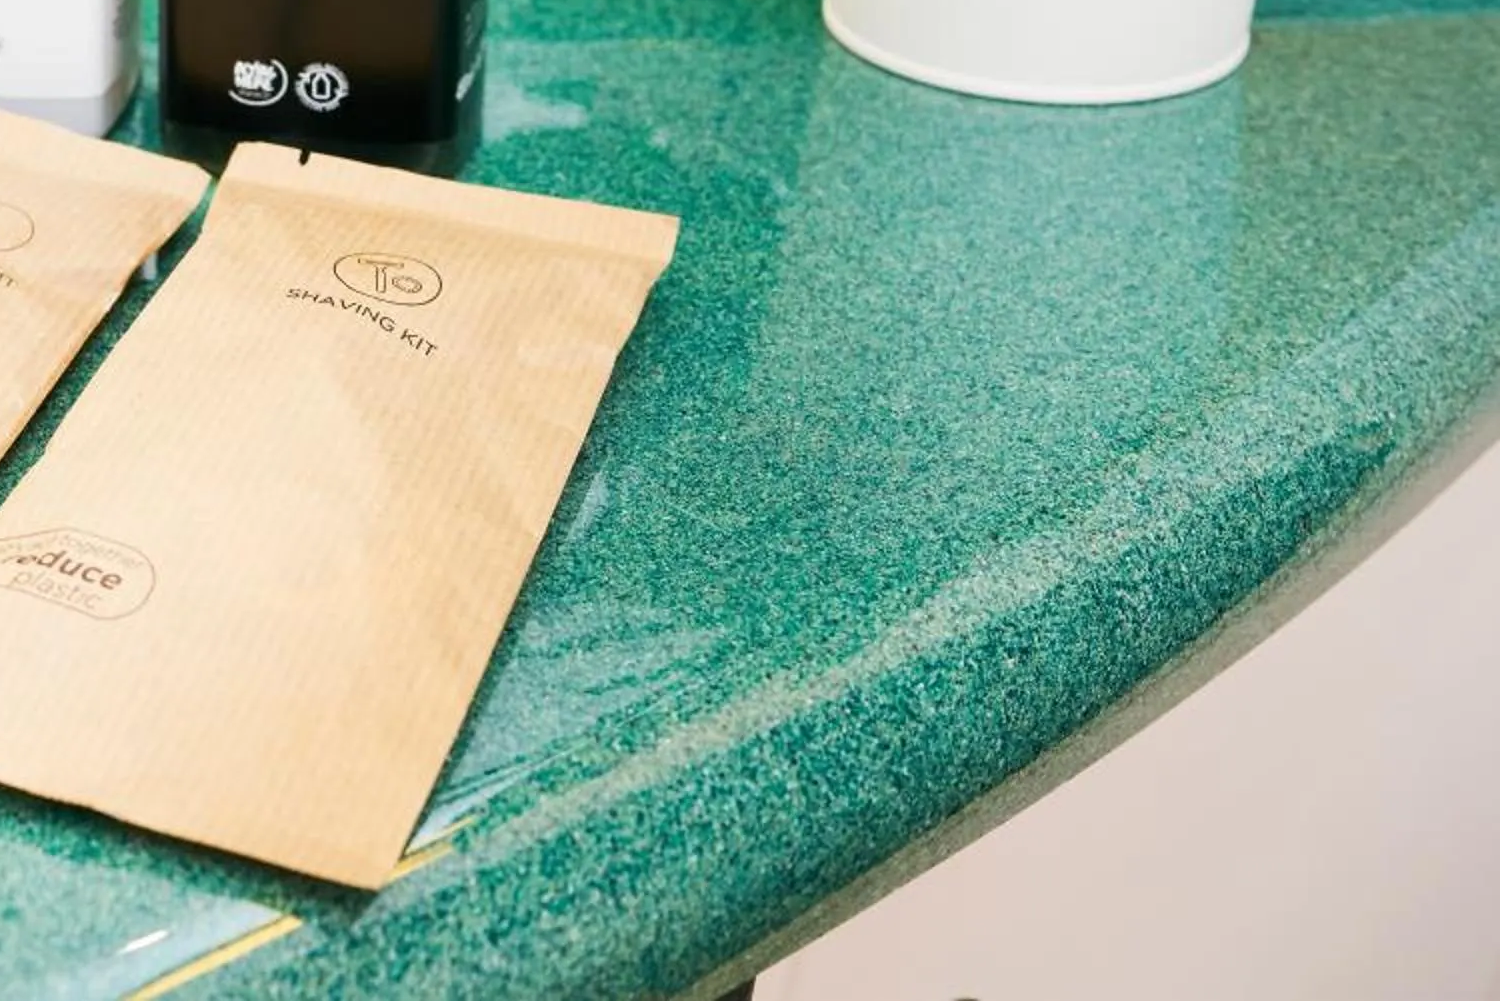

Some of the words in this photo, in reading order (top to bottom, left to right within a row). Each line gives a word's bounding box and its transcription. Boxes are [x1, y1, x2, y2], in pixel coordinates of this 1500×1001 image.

[286, 288, 397, 332] SHAVING
[400, 328, 438, 356] KIT
[1, 550, 123, 590] reduce
